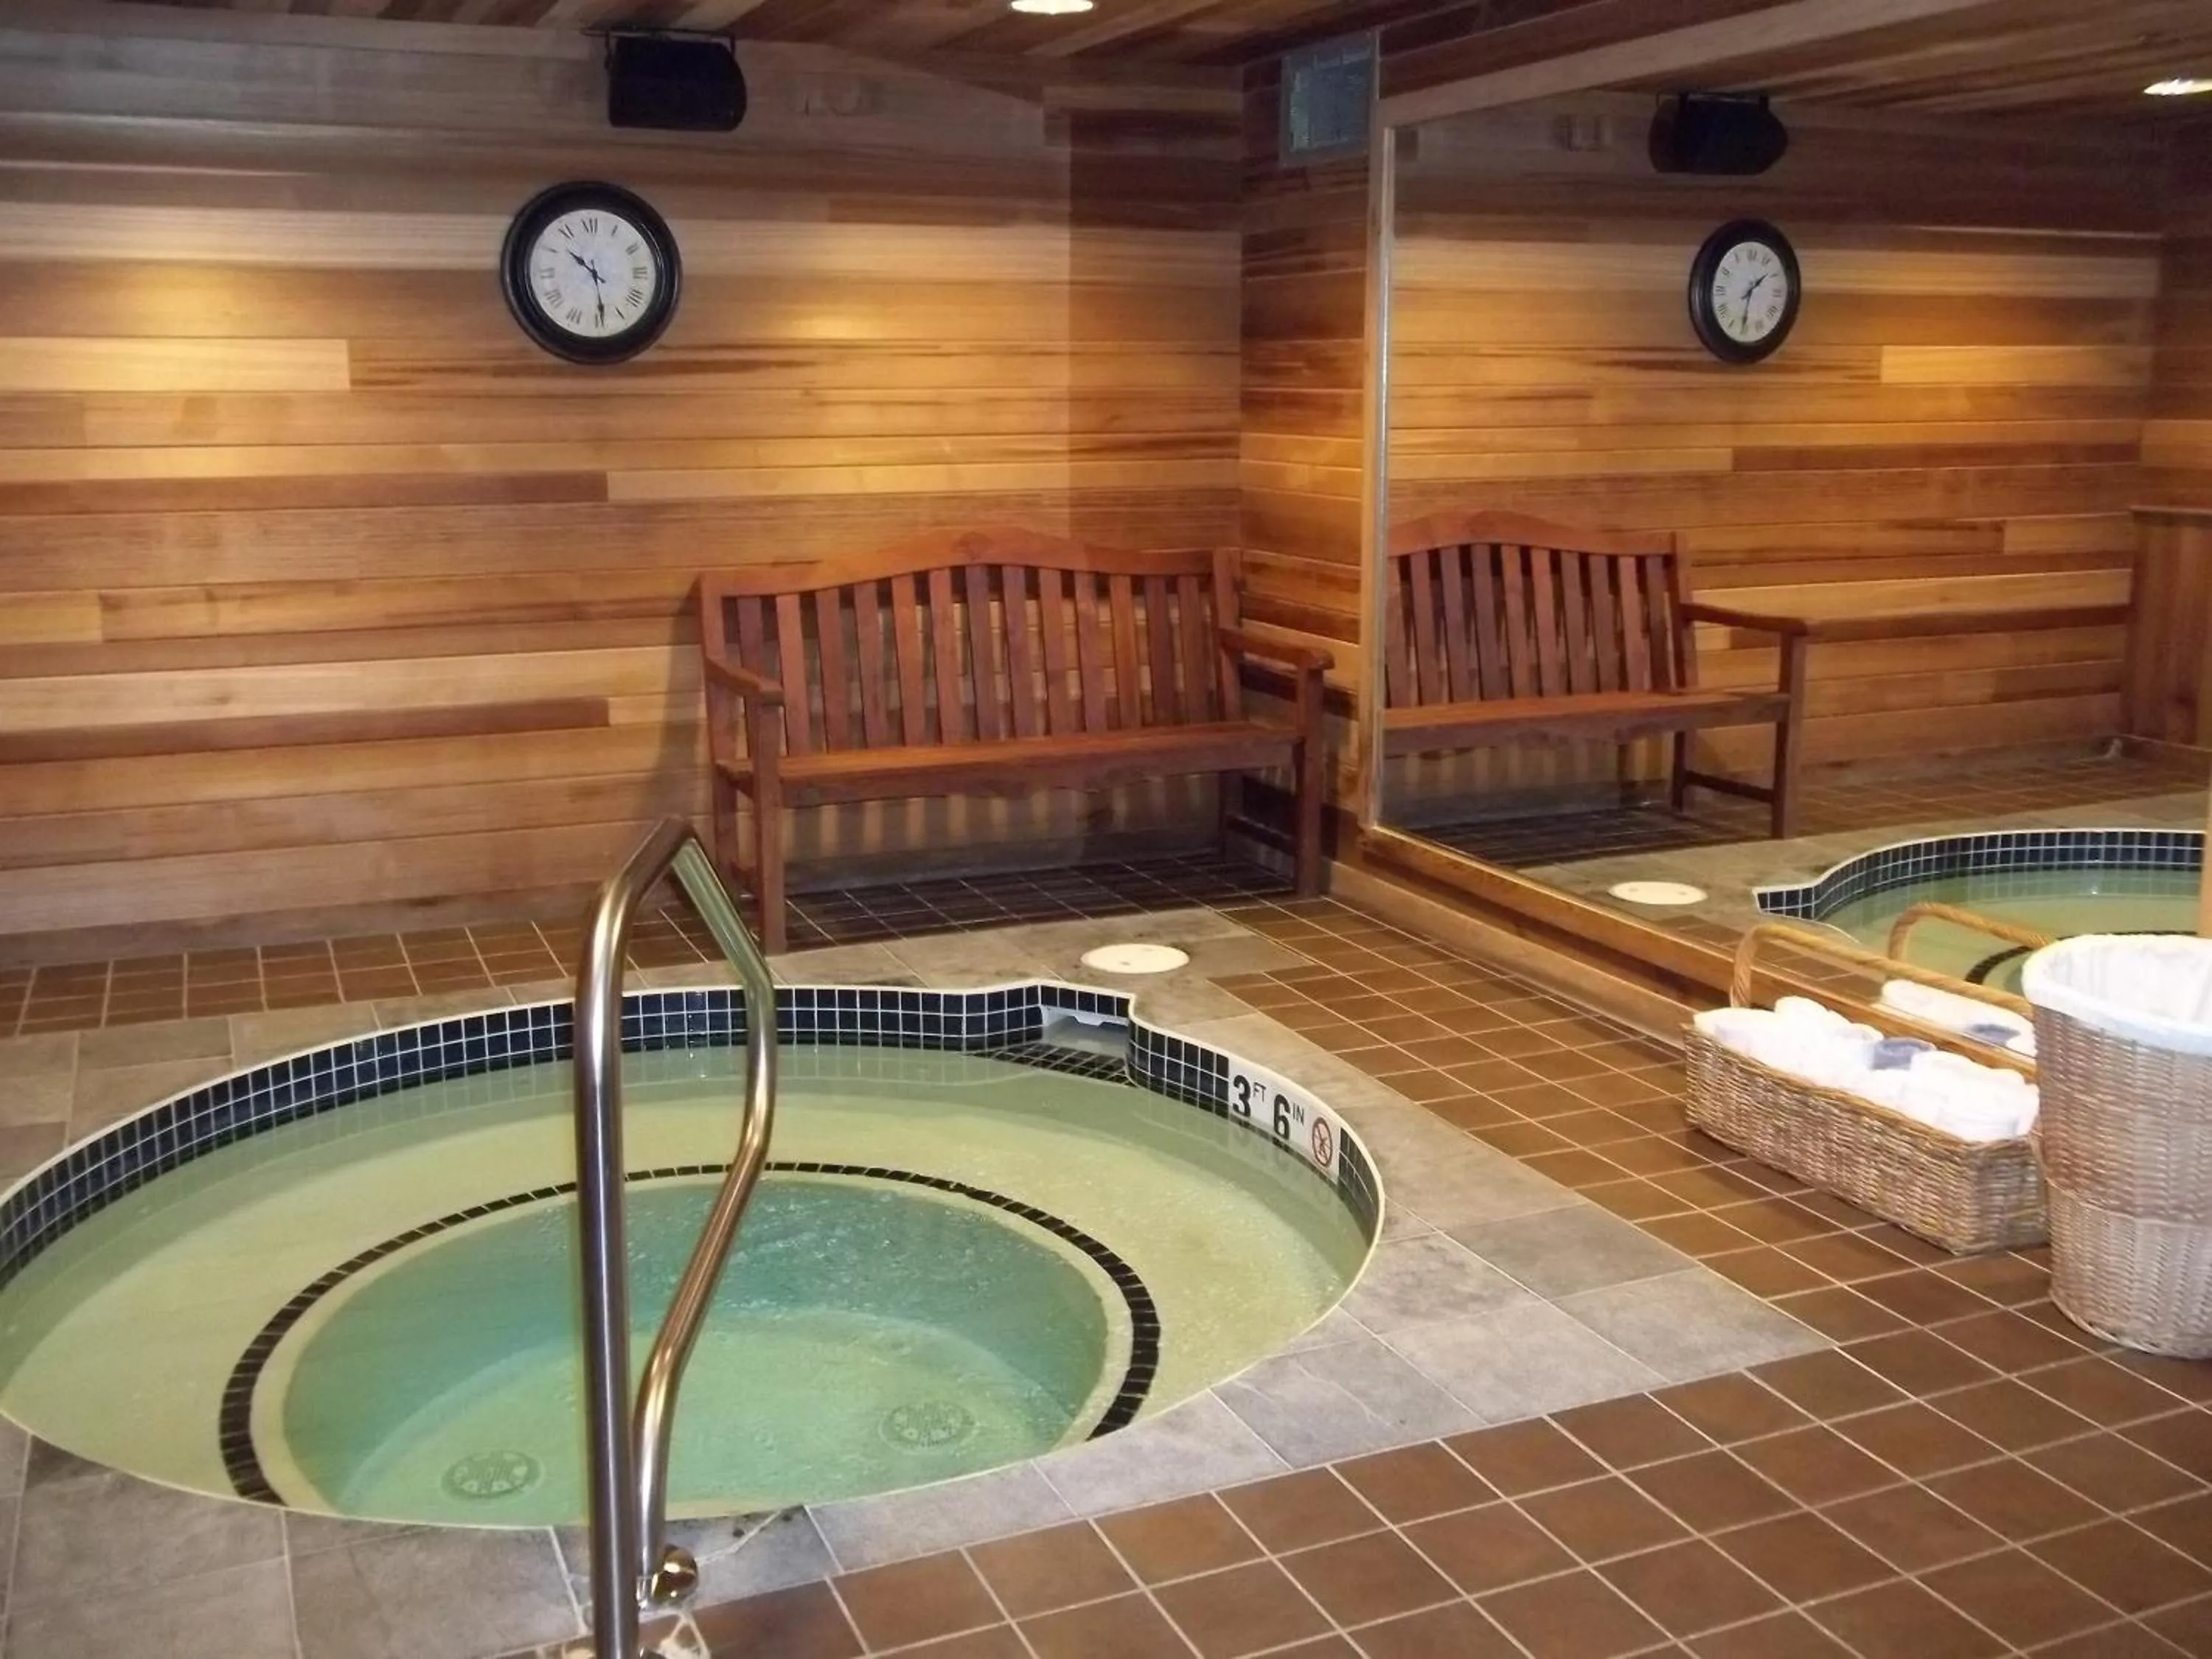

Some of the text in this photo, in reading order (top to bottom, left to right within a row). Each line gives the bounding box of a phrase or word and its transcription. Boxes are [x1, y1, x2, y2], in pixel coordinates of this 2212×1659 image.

[1232, 1074, 1305, 1141] 3 FT 6 IN
